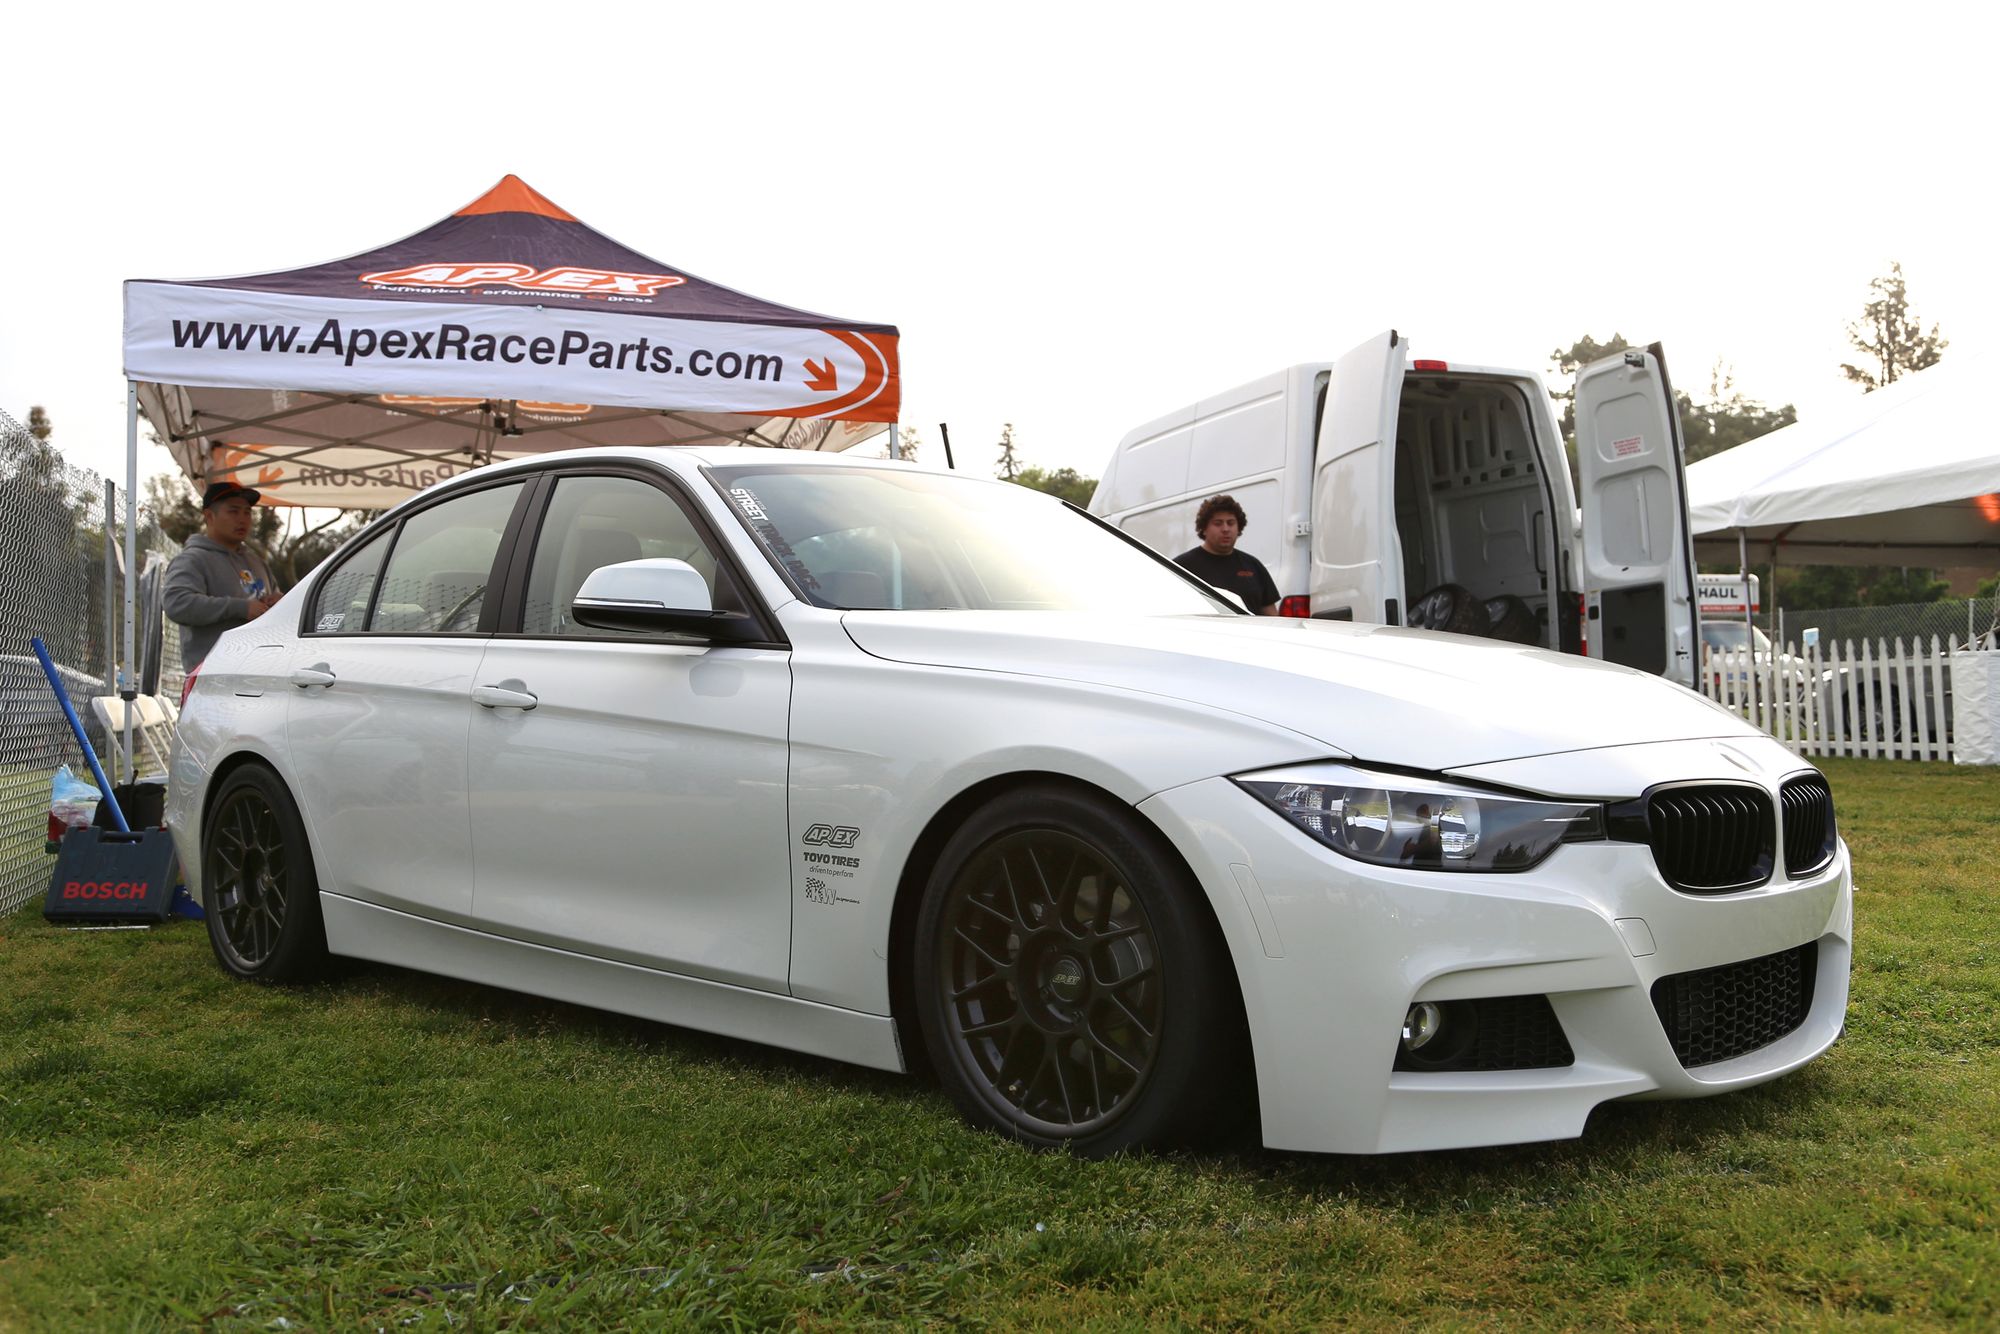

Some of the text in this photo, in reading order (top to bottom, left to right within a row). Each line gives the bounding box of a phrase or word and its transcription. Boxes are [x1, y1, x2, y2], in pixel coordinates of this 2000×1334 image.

[382, 266, 670, 293] APEX
[172, 319, 783, 382] www.ApexRaceParts.com
[730, 488, 768, 520] STREET
[804, 826, 858, 846] APEX
[832, 855, 860, 868] TIRES
[64, 881, 148, 899] BOSCH
